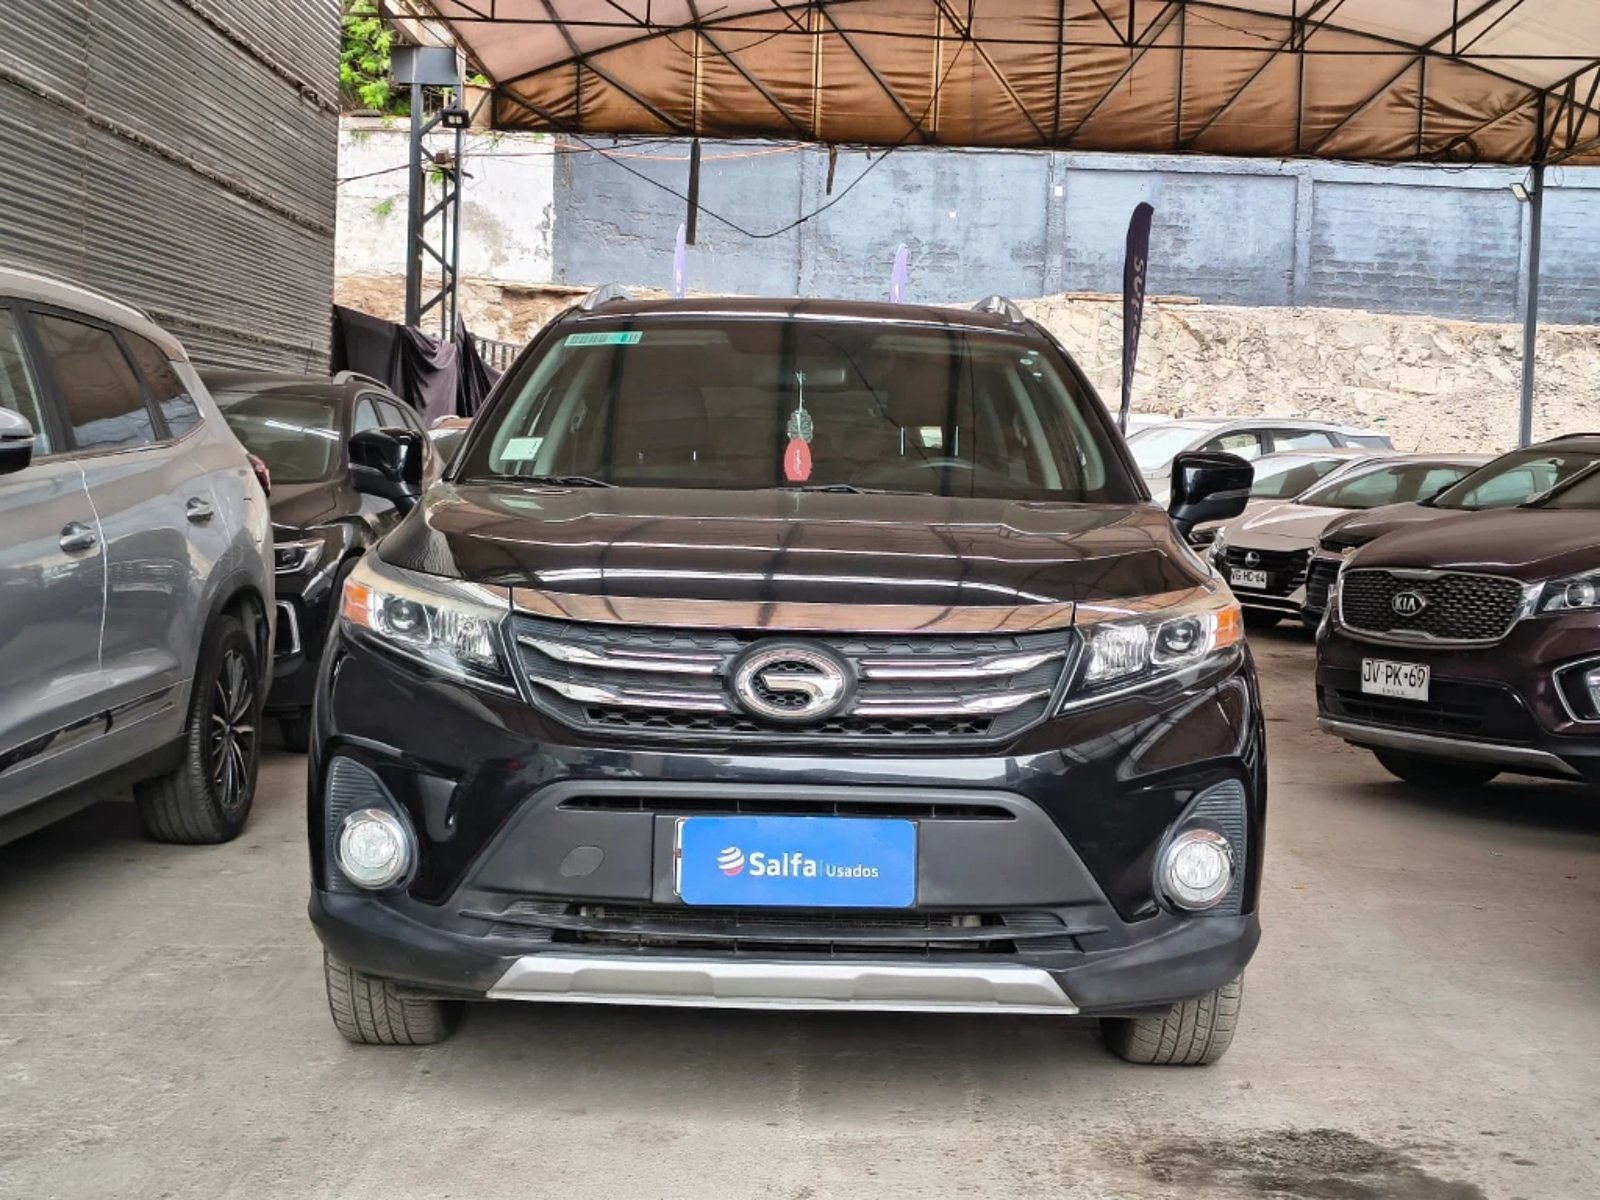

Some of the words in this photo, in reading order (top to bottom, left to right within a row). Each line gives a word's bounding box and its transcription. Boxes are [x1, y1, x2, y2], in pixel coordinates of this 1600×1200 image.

[1395, 596, 1416, 610] KIA
[749, 852, 817, 877] Salfa
[825, 864, 879, 878] Usados
